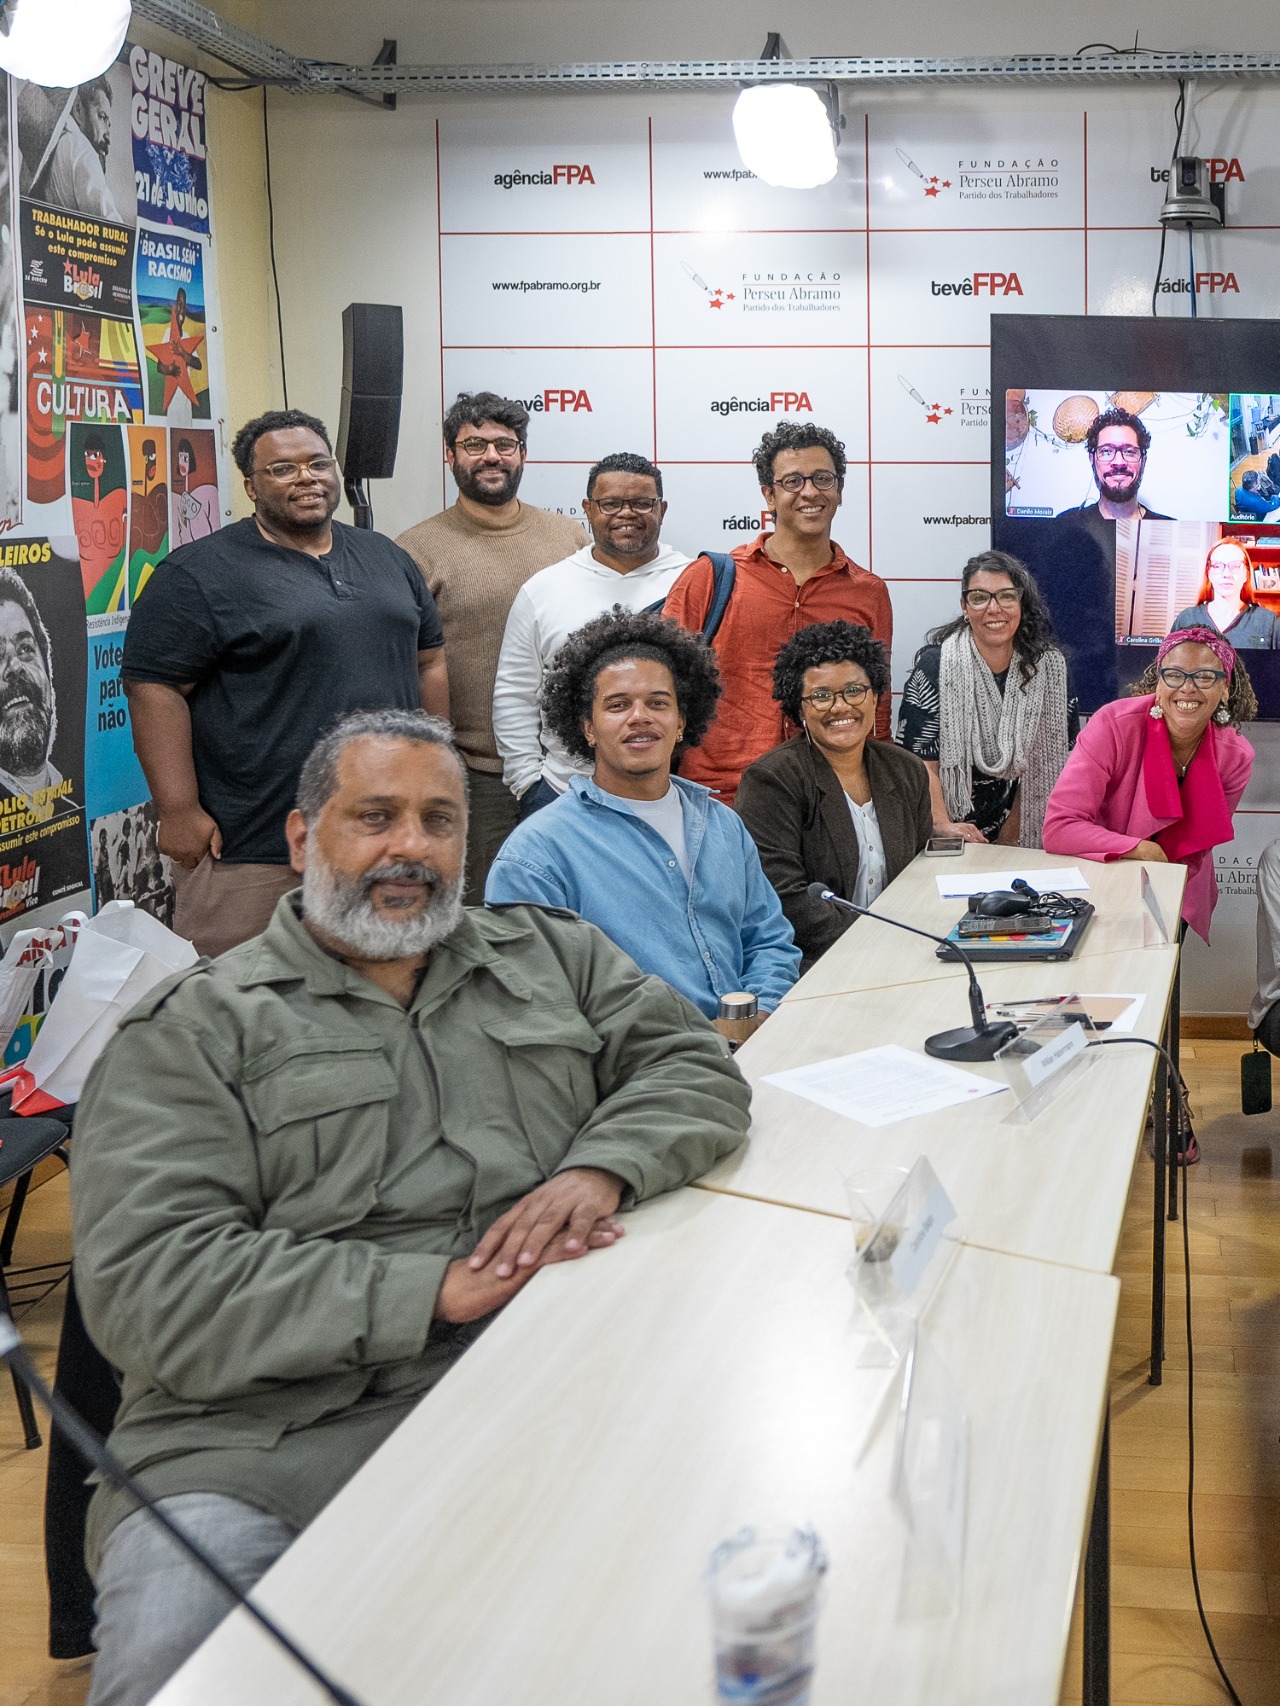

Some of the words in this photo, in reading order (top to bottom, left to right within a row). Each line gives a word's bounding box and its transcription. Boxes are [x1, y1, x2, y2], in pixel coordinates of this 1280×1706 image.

[130, 45, 206, 115] GREVE
[131, 92, 206, 160] GERAL
[703, 168, 758, 182] www.fpab
[959, 159, 1058, 171] FUNDAÇÃO
[494, 165, 595, 190] agênciaFPA
[959, 175, 1002, 188] Perseu
[1006, 175, 1059, 188] Abramo
[135, 171, 150, 200] 21
[151, 177, 166, 205] de
[165, 181, 208, 219] Junho
[959, 191, 989, 200] Partido
[989, 191, 1003, 199] dos
[1005, 191, 1059, 199] Trabalhadores
[32, 208, 101, 237] TRABALHADOR
[102, 226, 129, 244] RURAL
[34, 225, 46, 237] Só
[56, 231, 75, 245] Lula
[76, 236, 98, 251] pode
[99, 243, 127, 256] assumir
[48, 244, 66, 256] este
[67, 248, 118, 267] compromisso
[141, 238, 181, 262] BRASIL
[181, 245, 196, 266] SEM
[72, 264, 101, 286] Lula
[147, 260, 192, 284] RACISMO
[743, 272, 841, 282] FUNDAÇÃO
[63, 275, 104, 300] Brasil
[491, 280, 602, 294] www.fpabramo.org.br
[744, 287, 785, 300] Perseu
[789, 287, 841, 300] Abramo
[931, 272, 1024, 296] tevêFPA
[743, 303, 771, 311] Partido
[772, 303, 786, 311] dos
[788, 303, 841, 311] Trabalhadores
[36, 381, 131, 419] CULTURA
[711, 392, 813, 416] agênciaFPA
[961, 418, 988, 427] Partido
[722, 510, 774, 531] rádioF
[1016, 508, 1033, 516] Danilo
[1034, 508, 1053, 517] Morais
[1230, 513, 1255, 521] Auditório
[1126, 636, 1147, 644] Carolina
[24, 829, 39, 844] este
[40, 815, 80, 837] compromisso
[25, 896, 39, 908] Vice
